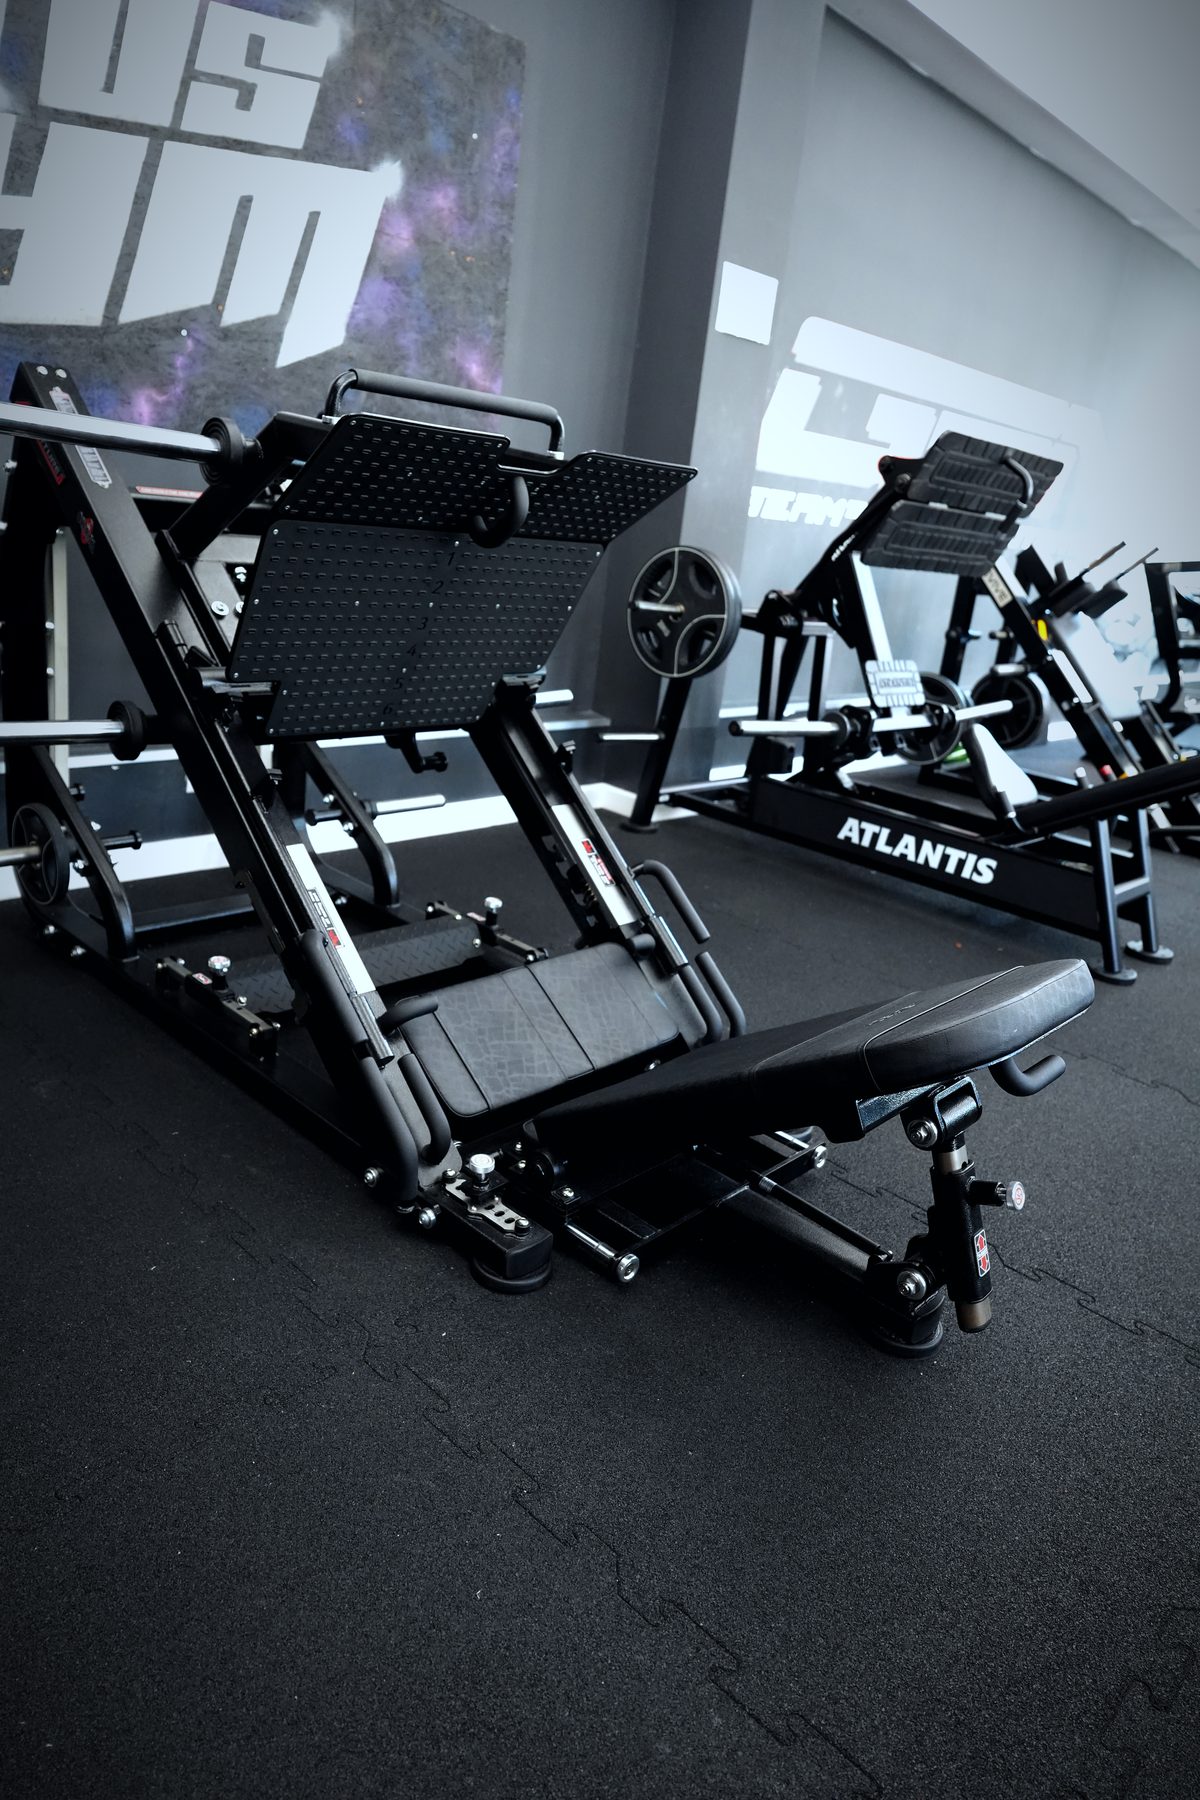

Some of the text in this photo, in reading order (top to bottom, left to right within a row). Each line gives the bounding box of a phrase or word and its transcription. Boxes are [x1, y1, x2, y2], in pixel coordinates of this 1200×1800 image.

[431, 580, 444, 594] 2
[417, 617, 429, 630] 3
[836, 816, 998, 885] ATLANTIS
